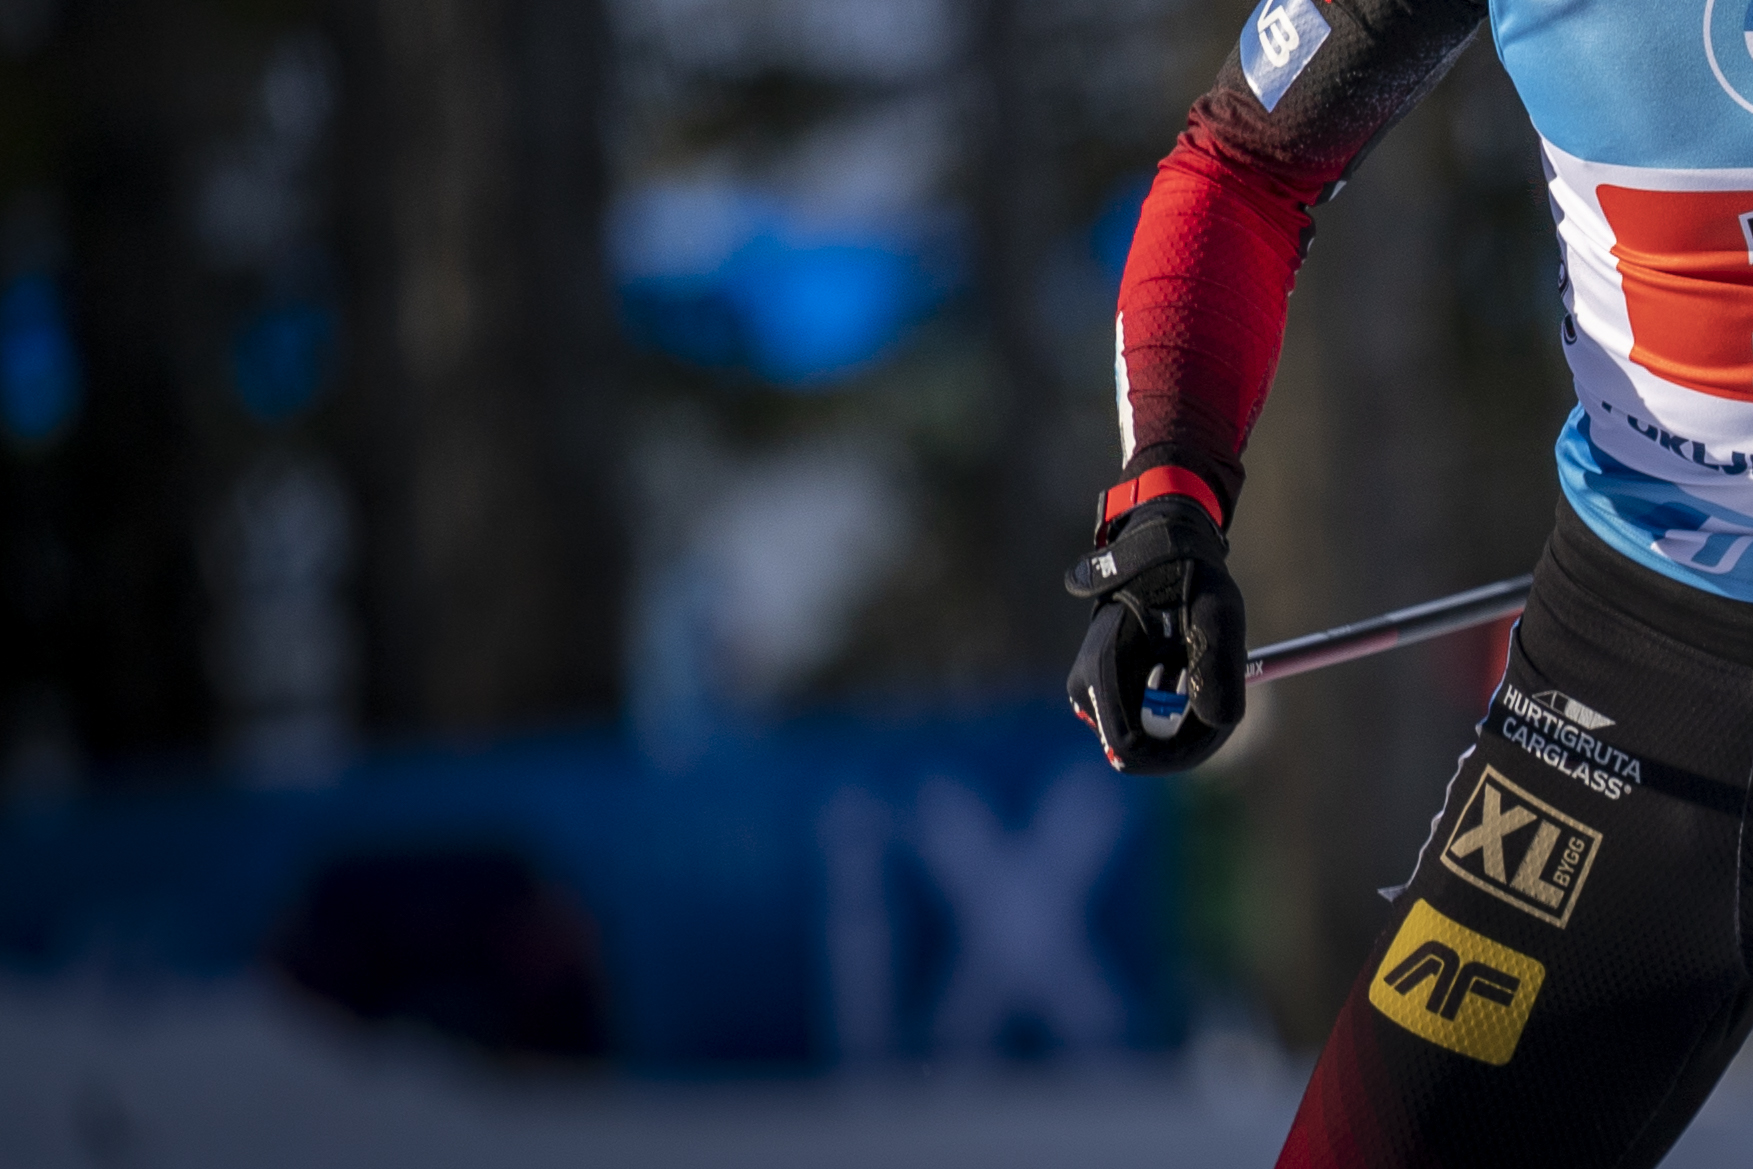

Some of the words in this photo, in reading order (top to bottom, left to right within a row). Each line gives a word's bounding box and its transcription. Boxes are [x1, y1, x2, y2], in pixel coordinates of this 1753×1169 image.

[1503, 684, 1641, 784] HURTIGRUTA
[1450, 782, 1565, 910] XL
[1552, 836, 1586, 888] BYGG
